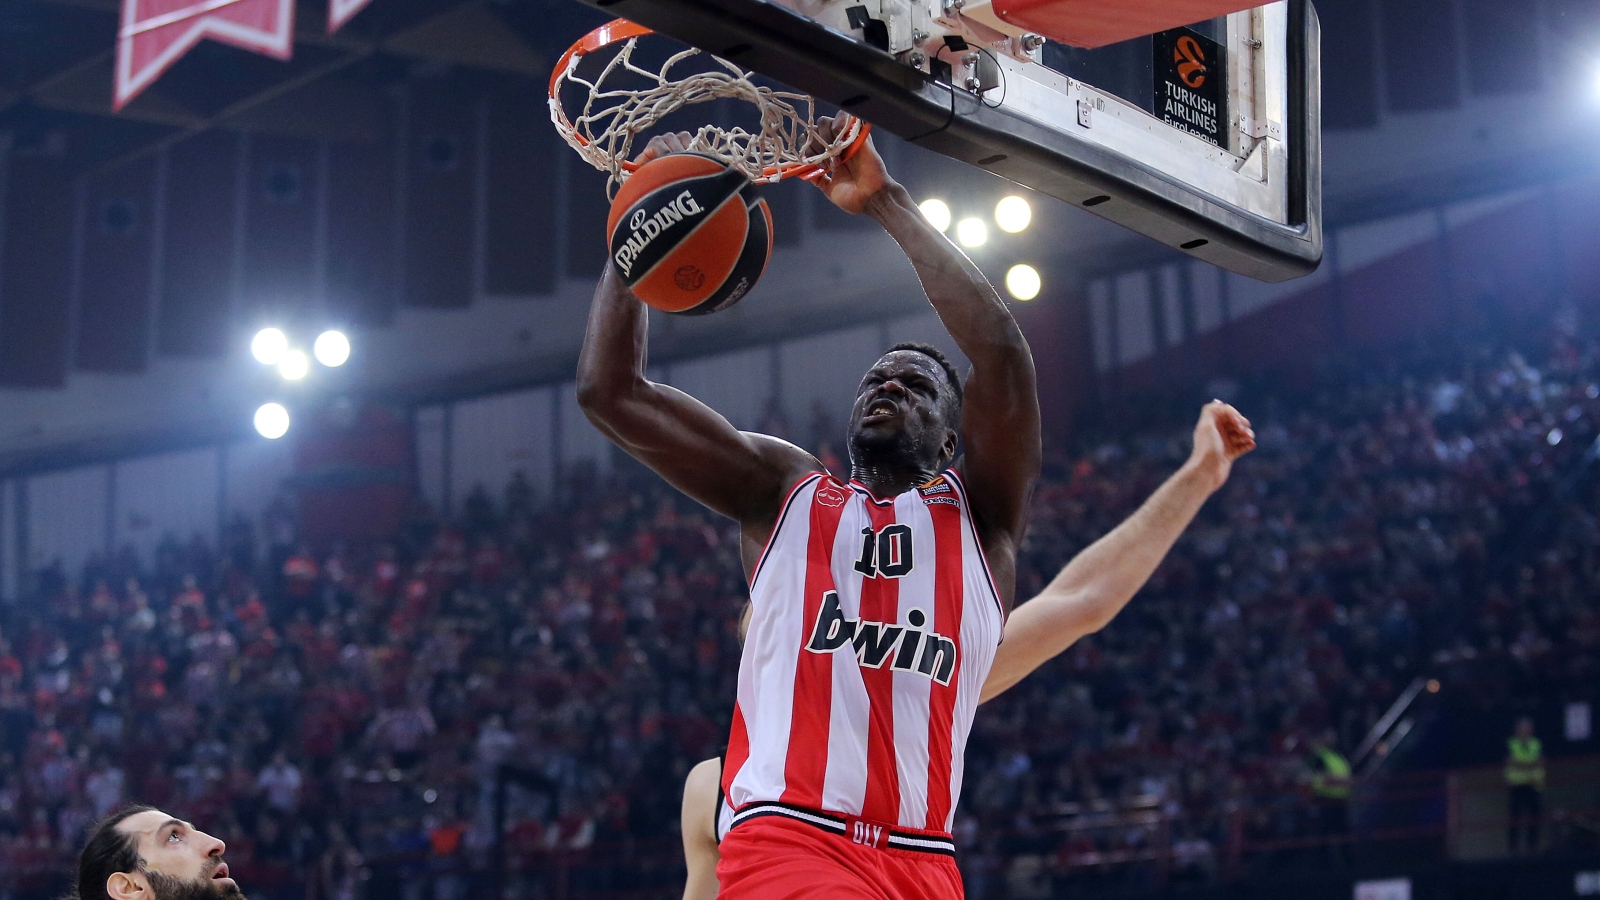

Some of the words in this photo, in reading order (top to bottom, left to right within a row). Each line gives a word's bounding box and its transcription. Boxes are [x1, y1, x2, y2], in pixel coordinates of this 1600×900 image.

[1165, 80, 1217, 117] TURKISH
[1165, 98, 1218, 134] AIRLINES
[615, 190, 702, 278] SPALDING
[852, 523, 914, 580] 10
[804, 589, 957, 688] bwin
[852, 820, 883, 849] OLY
